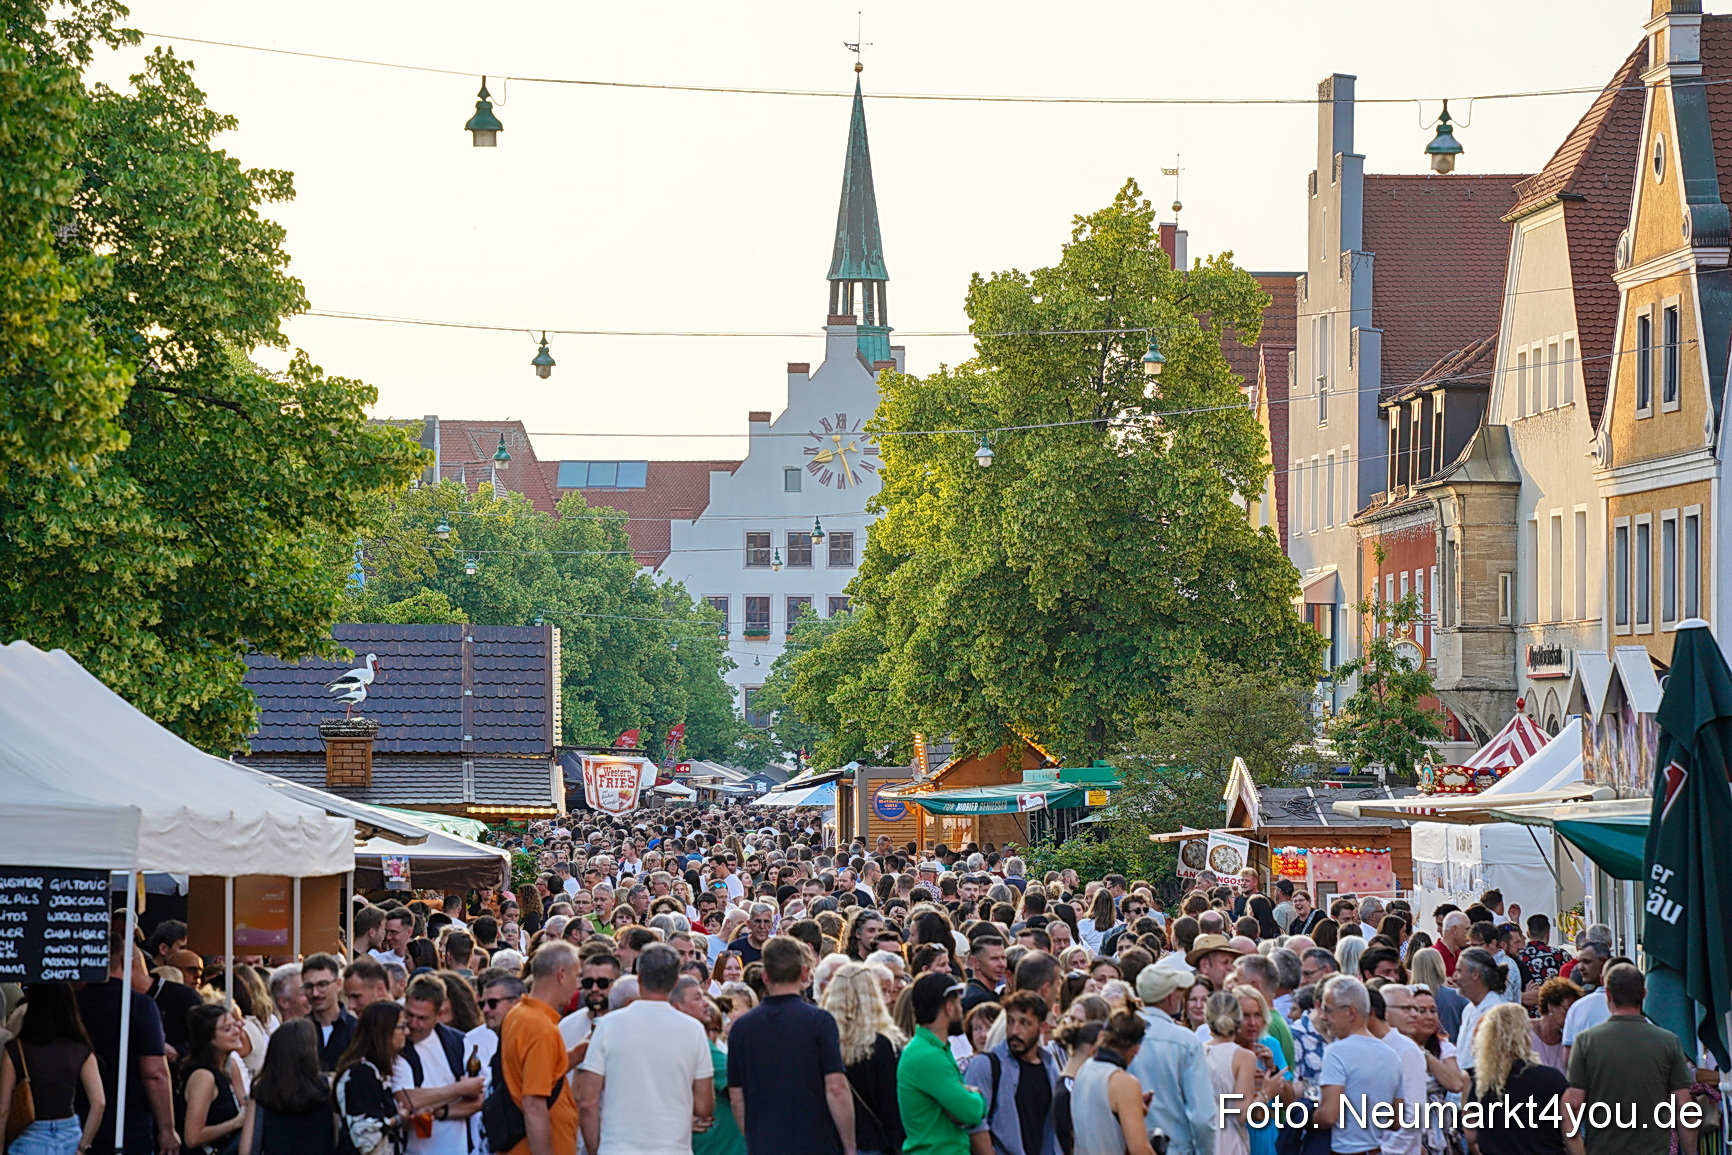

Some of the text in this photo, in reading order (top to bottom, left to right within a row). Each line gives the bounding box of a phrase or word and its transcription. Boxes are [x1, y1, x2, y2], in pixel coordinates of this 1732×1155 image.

[819, 417, 833, 434] XI
[836, 413, 847, 429] XII
[819, 469, 833, 487] VII
[603, 766, 631, 777] Western
[599, 775, 635, 789] FRIES
[1651, 863, 1675, 885] er
[1645, 885, 1684, 925] äu
[41, 968, 80, 980] SHOTS
